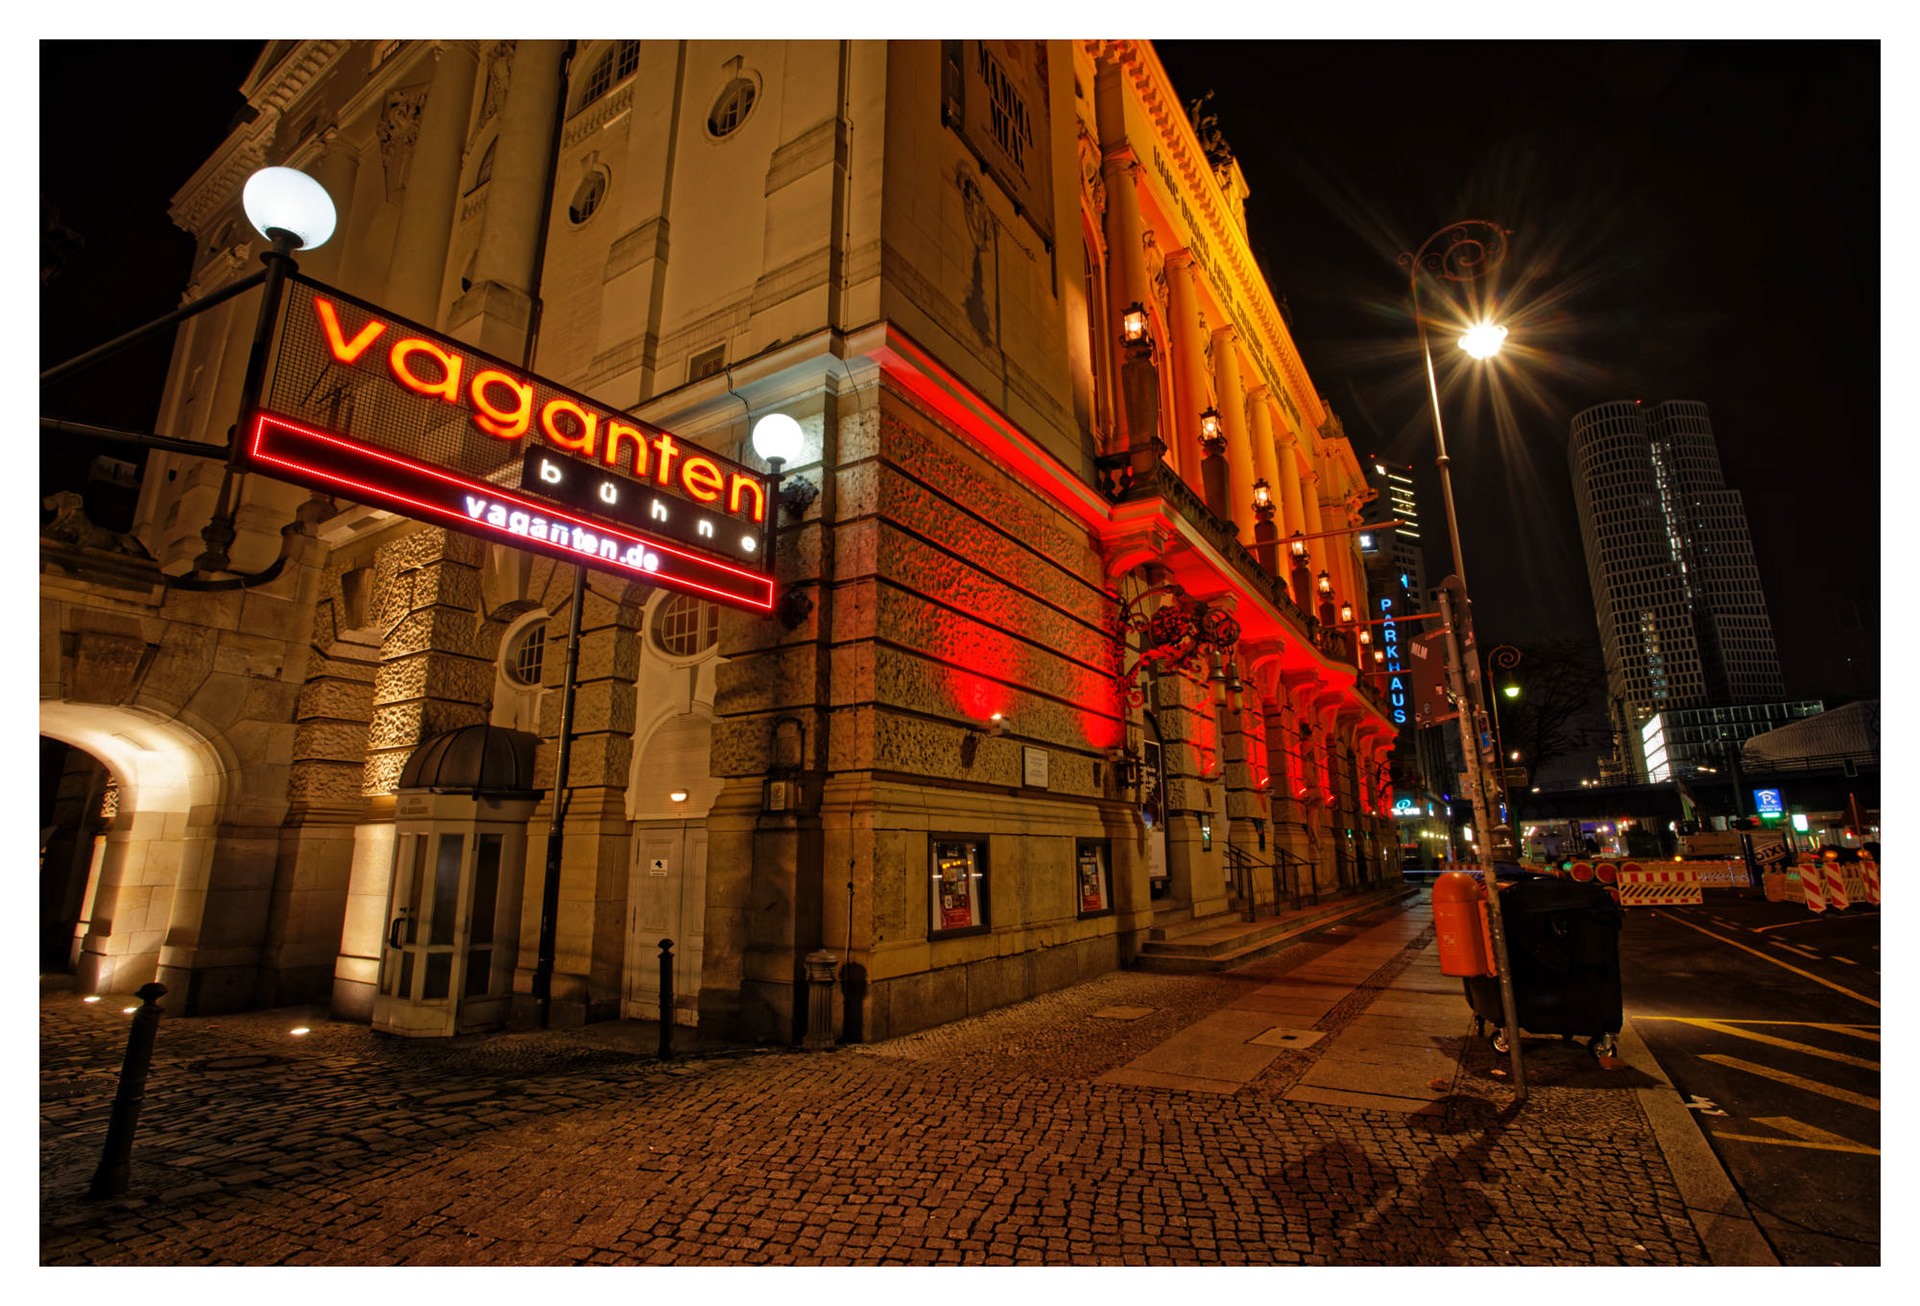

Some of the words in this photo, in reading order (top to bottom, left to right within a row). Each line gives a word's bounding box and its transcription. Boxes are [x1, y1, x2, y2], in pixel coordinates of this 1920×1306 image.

[314, 297, 764, 523] vaganten
[465, 495, 660, 573] vaganten.de
[540, 458, 756, 552] bühne
[1381, 598, 1406, 723] PARKHAUS
